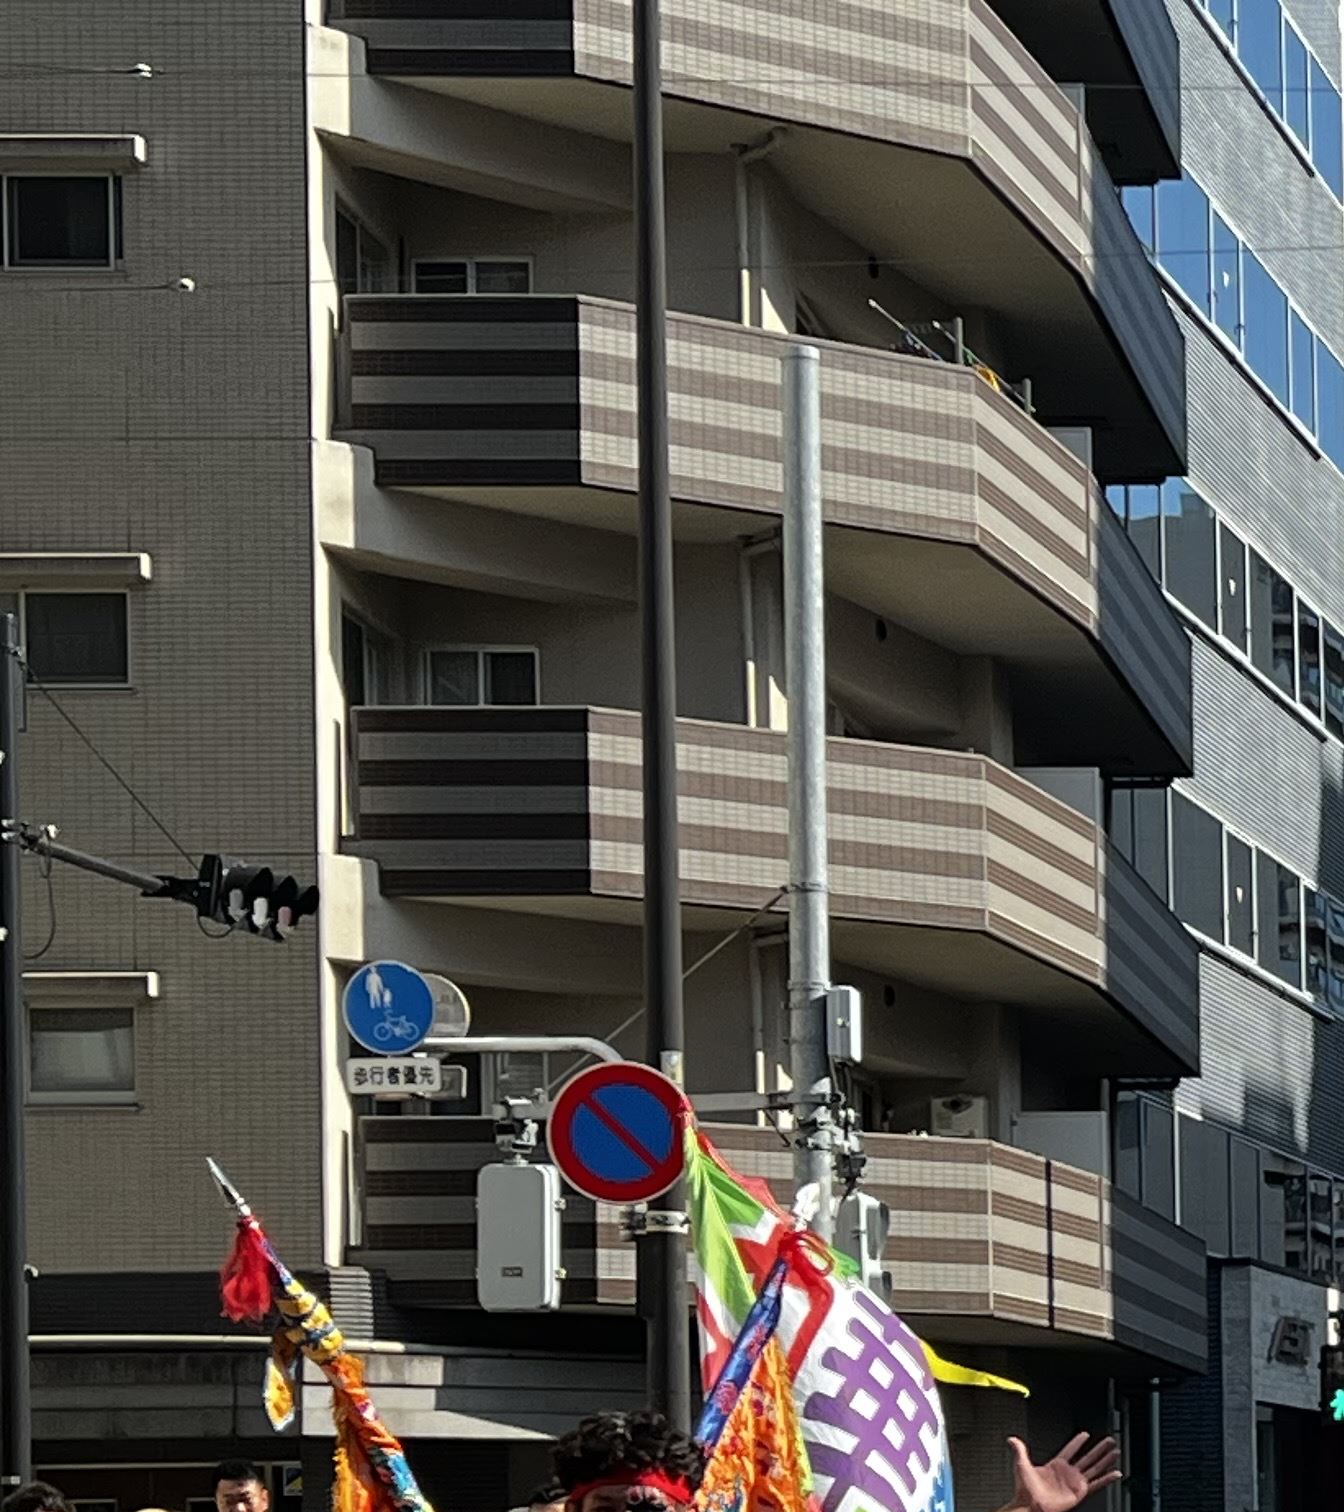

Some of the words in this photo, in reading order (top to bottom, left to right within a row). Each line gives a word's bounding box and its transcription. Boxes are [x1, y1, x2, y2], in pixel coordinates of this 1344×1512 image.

[354, 1065, 435, 1086] 歩行者優先
